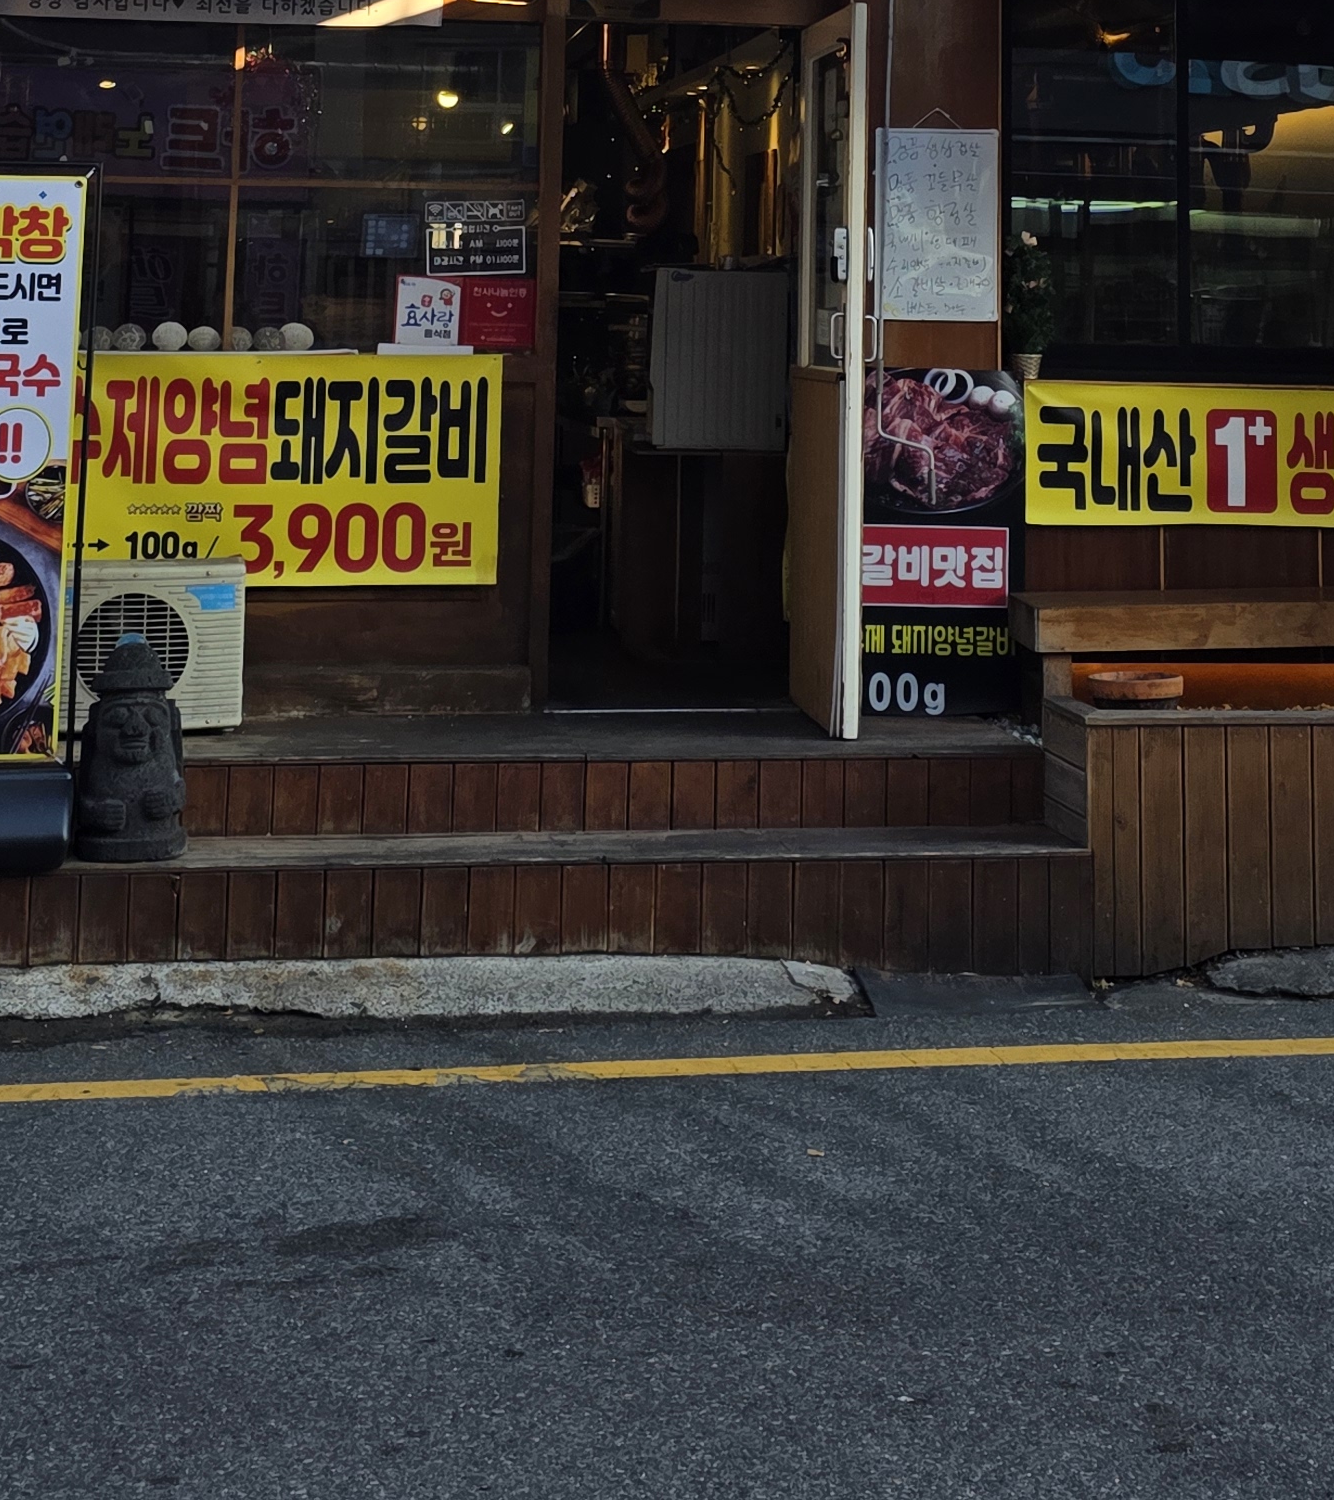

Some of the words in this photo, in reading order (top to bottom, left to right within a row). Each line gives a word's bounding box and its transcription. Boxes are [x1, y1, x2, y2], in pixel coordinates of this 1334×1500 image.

[401, 303, 455, 328] 효사랑
[1037, 405, 1195, 514] 국내산
[185, 502, 224, 522] 깜짝
[862, 544, 1003, 589] 갈비맛집
[861, 624, 885, 654] 제
